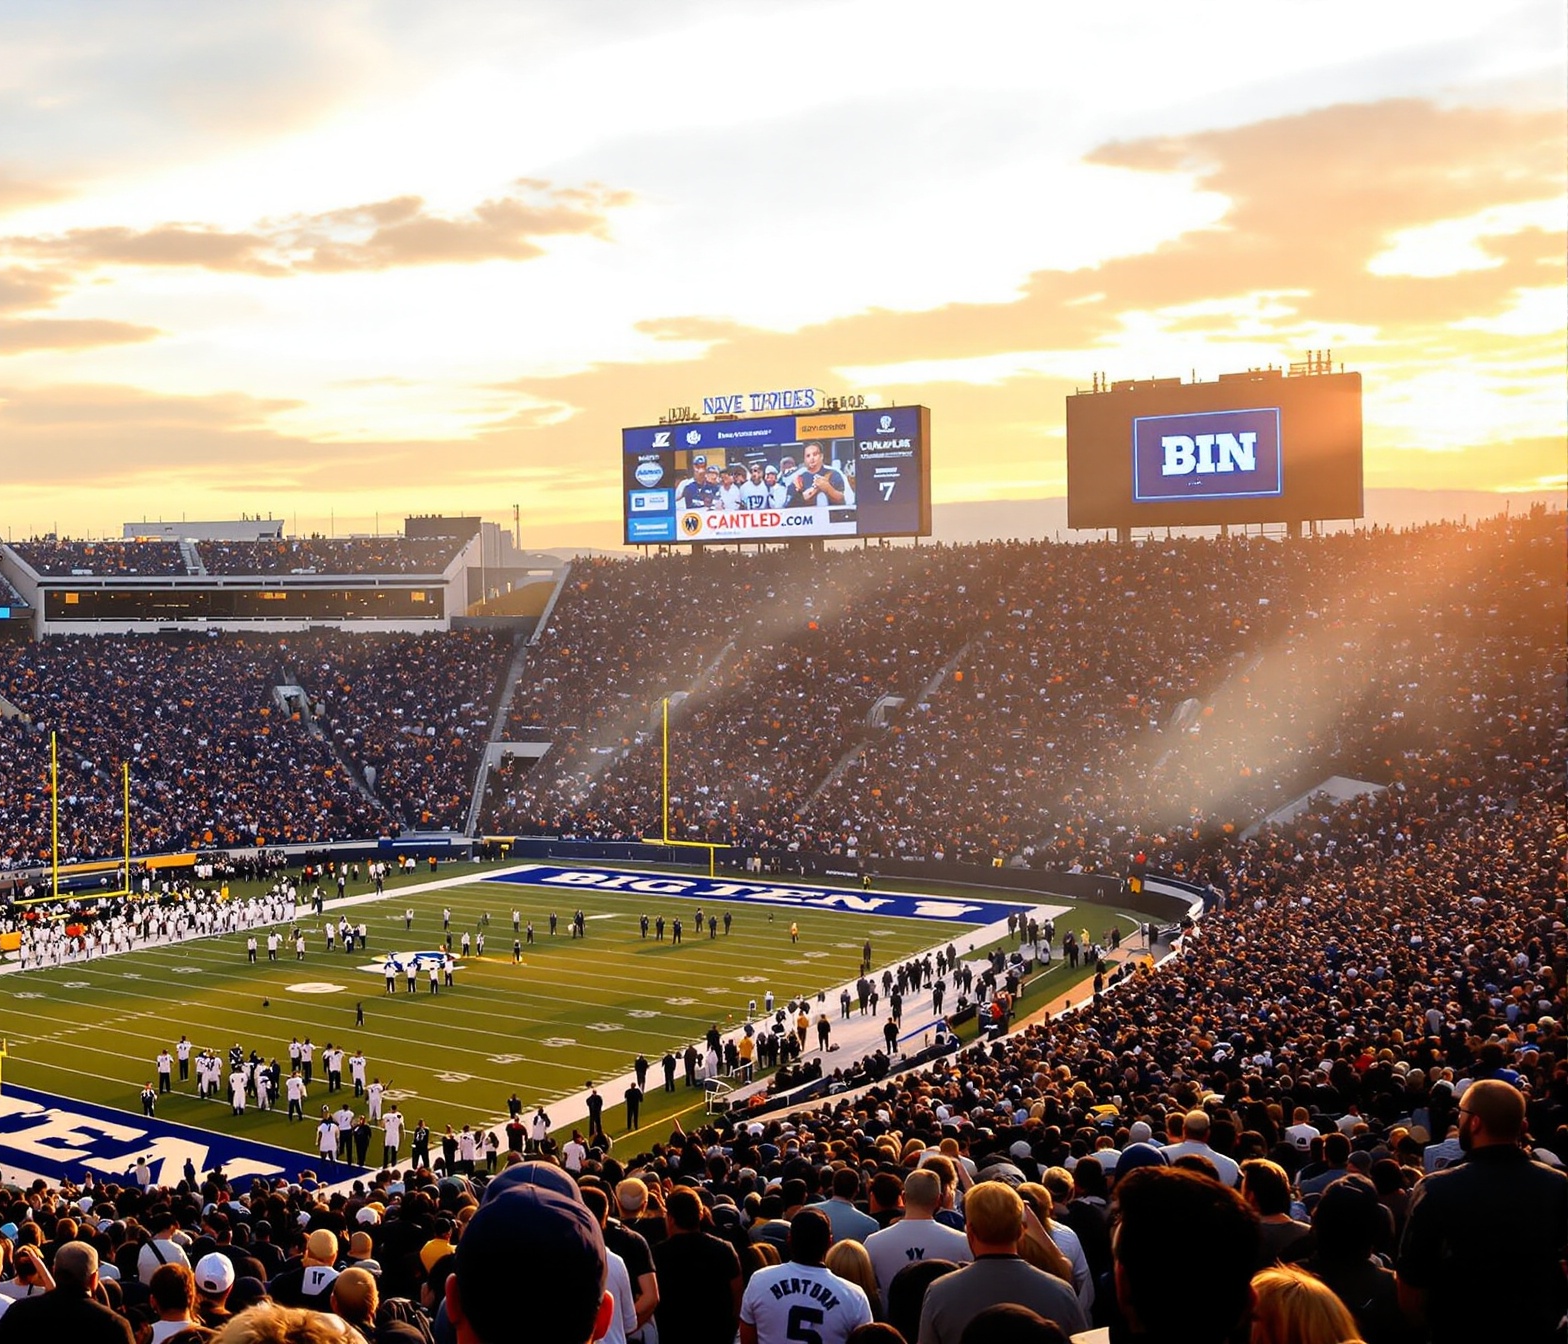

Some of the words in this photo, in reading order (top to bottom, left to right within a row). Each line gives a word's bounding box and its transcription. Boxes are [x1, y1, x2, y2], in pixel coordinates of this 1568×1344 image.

[1162, 432, 1257, 476] BIN
[879, 481, 895, 501] 7
[541, 872, 698, 894] BIG
[693, 883, 895, 911] TEN
[787, 1304, 824, 1344] 5
